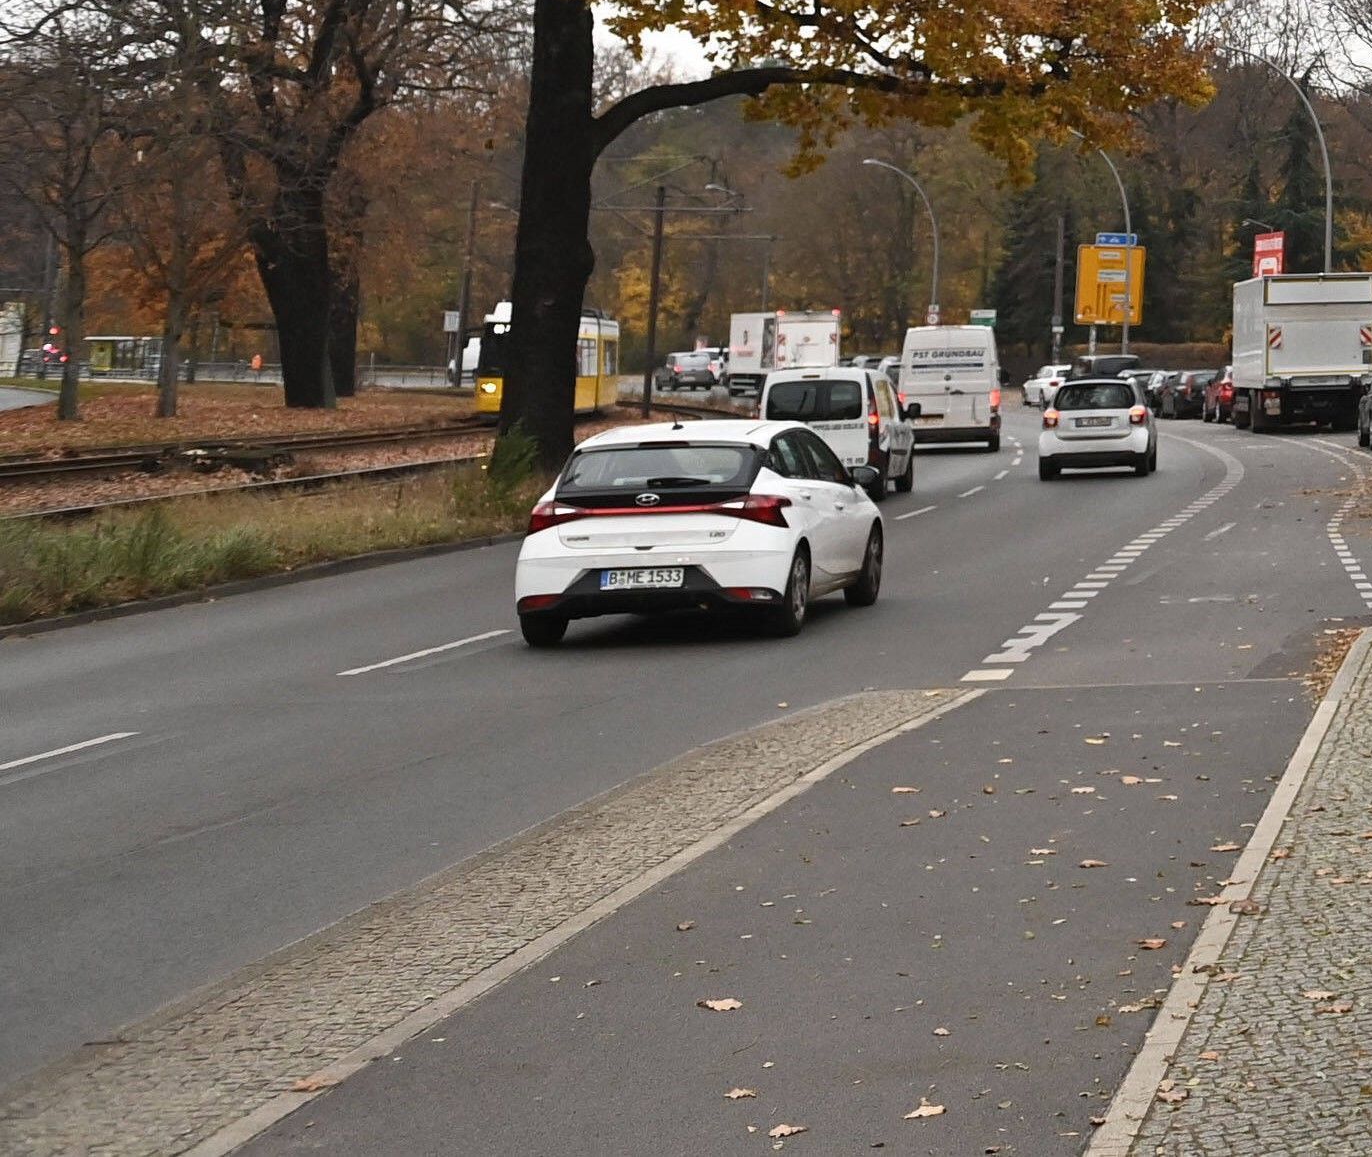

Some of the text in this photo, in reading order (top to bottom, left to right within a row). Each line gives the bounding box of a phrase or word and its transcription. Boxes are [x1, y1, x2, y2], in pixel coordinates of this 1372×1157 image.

[609, 570, 681, 585] B ME 1533
